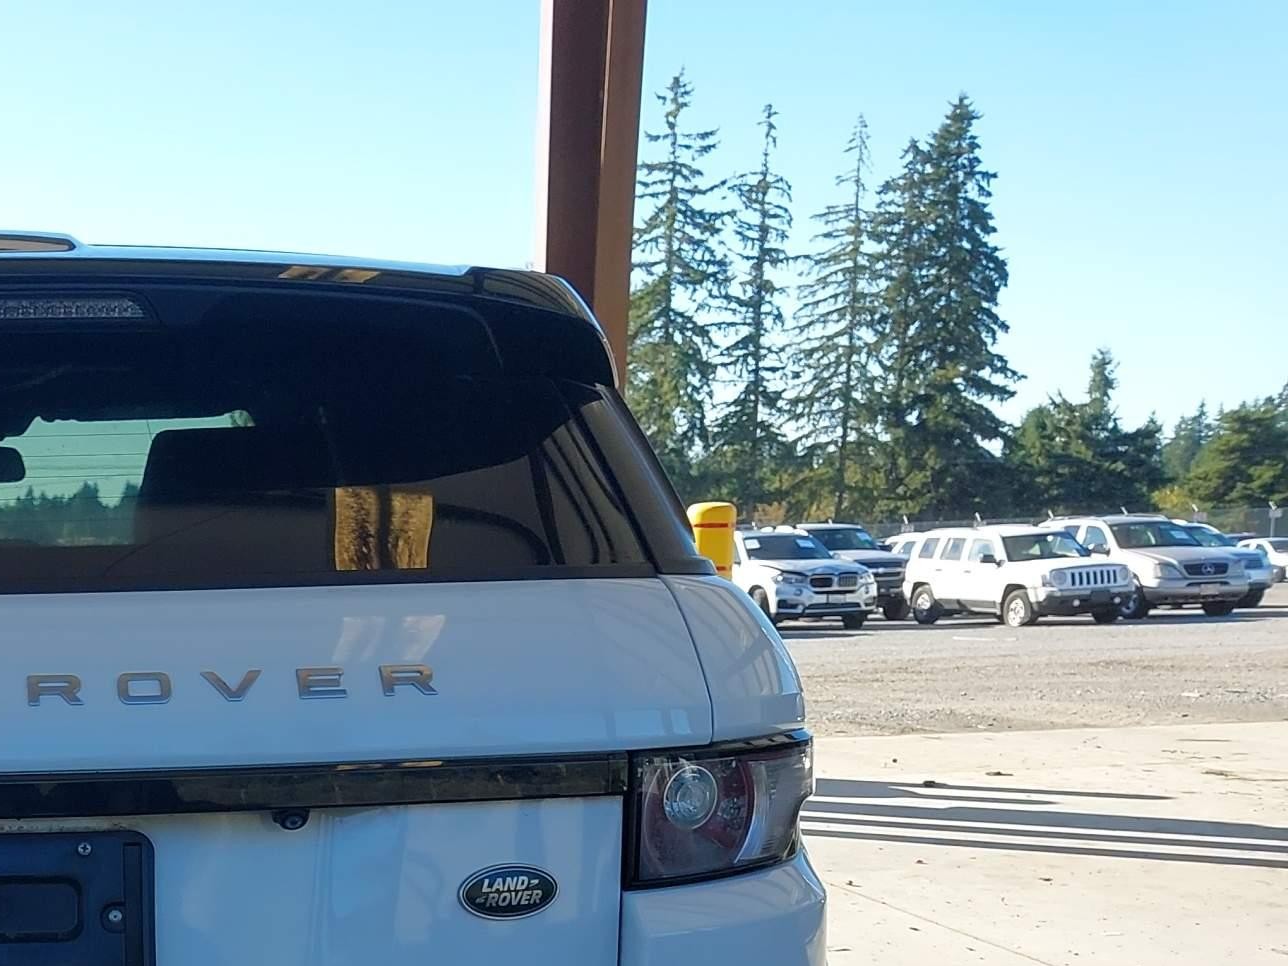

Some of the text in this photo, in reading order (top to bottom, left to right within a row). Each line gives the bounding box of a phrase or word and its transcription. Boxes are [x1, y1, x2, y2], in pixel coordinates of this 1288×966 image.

[26, 662, 439, 706] ROVER
[481, 875, 529, 893] LAND
[485, 889, 543, 907] ROVER
